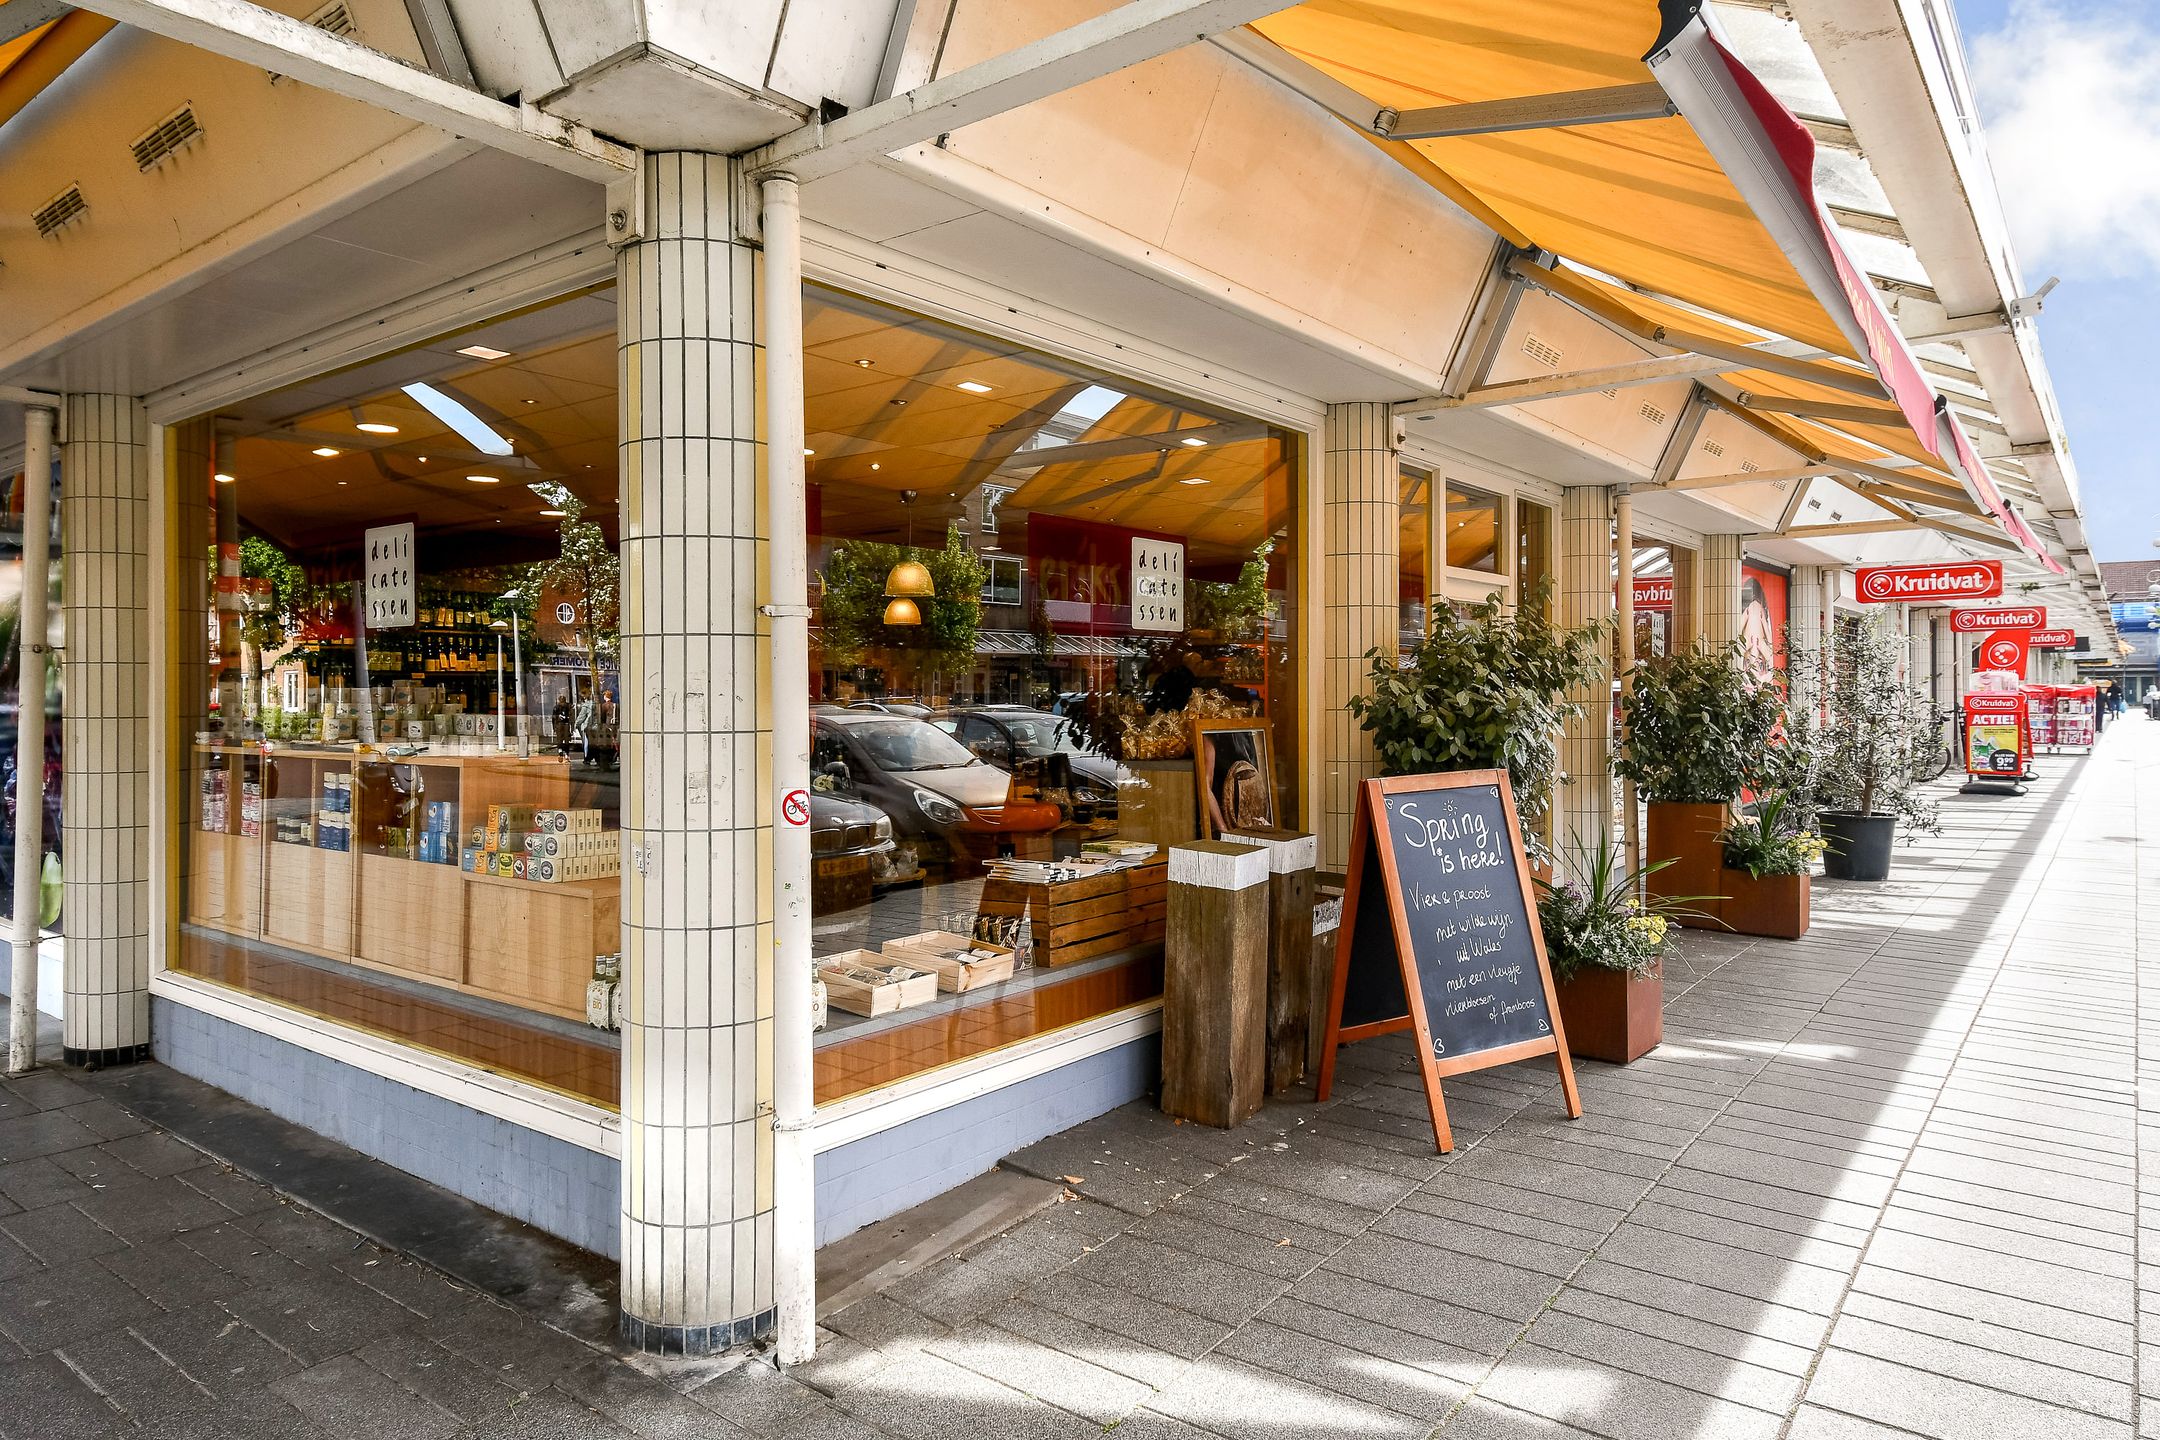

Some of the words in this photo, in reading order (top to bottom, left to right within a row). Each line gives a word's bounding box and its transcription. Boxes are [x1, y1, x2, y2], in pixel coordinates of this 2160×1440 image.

[371, 566, 408, 589] cate
[1138, 578, 1178, 598] cate
[1895, 571, 1984, 592] Kruidvat
[373, 598, 408, 619] ssen
[1139, 603, 1178, 623] ssen
[1976, 612, 2035, 626] Kruidvat
[2030, 632, 2067, 643] ruidvat
[1981, 699, 2015, 707] Kruidvat
[1971, 714, 2016, 725] ACTIE!
[1436, 848, 1455, 875] is
[1441, 890, 1451, 904] &
[1453, 884, 1492, 910] proost
[1435, 918, 1457, 943] met
[1458, 912, 1487, 933] wilde
[1455, 939, 1471, 963] uit
[1469, 936, 1502, 957] Wales
[1446, 973, 1467, 994] met
[1469, 970, 1487, 986] een
[1487, 962, 1522, 986] vleugje
[1488, 1005, 1499, 1025] of
[1500, 998, 1536, 1025] framboos
